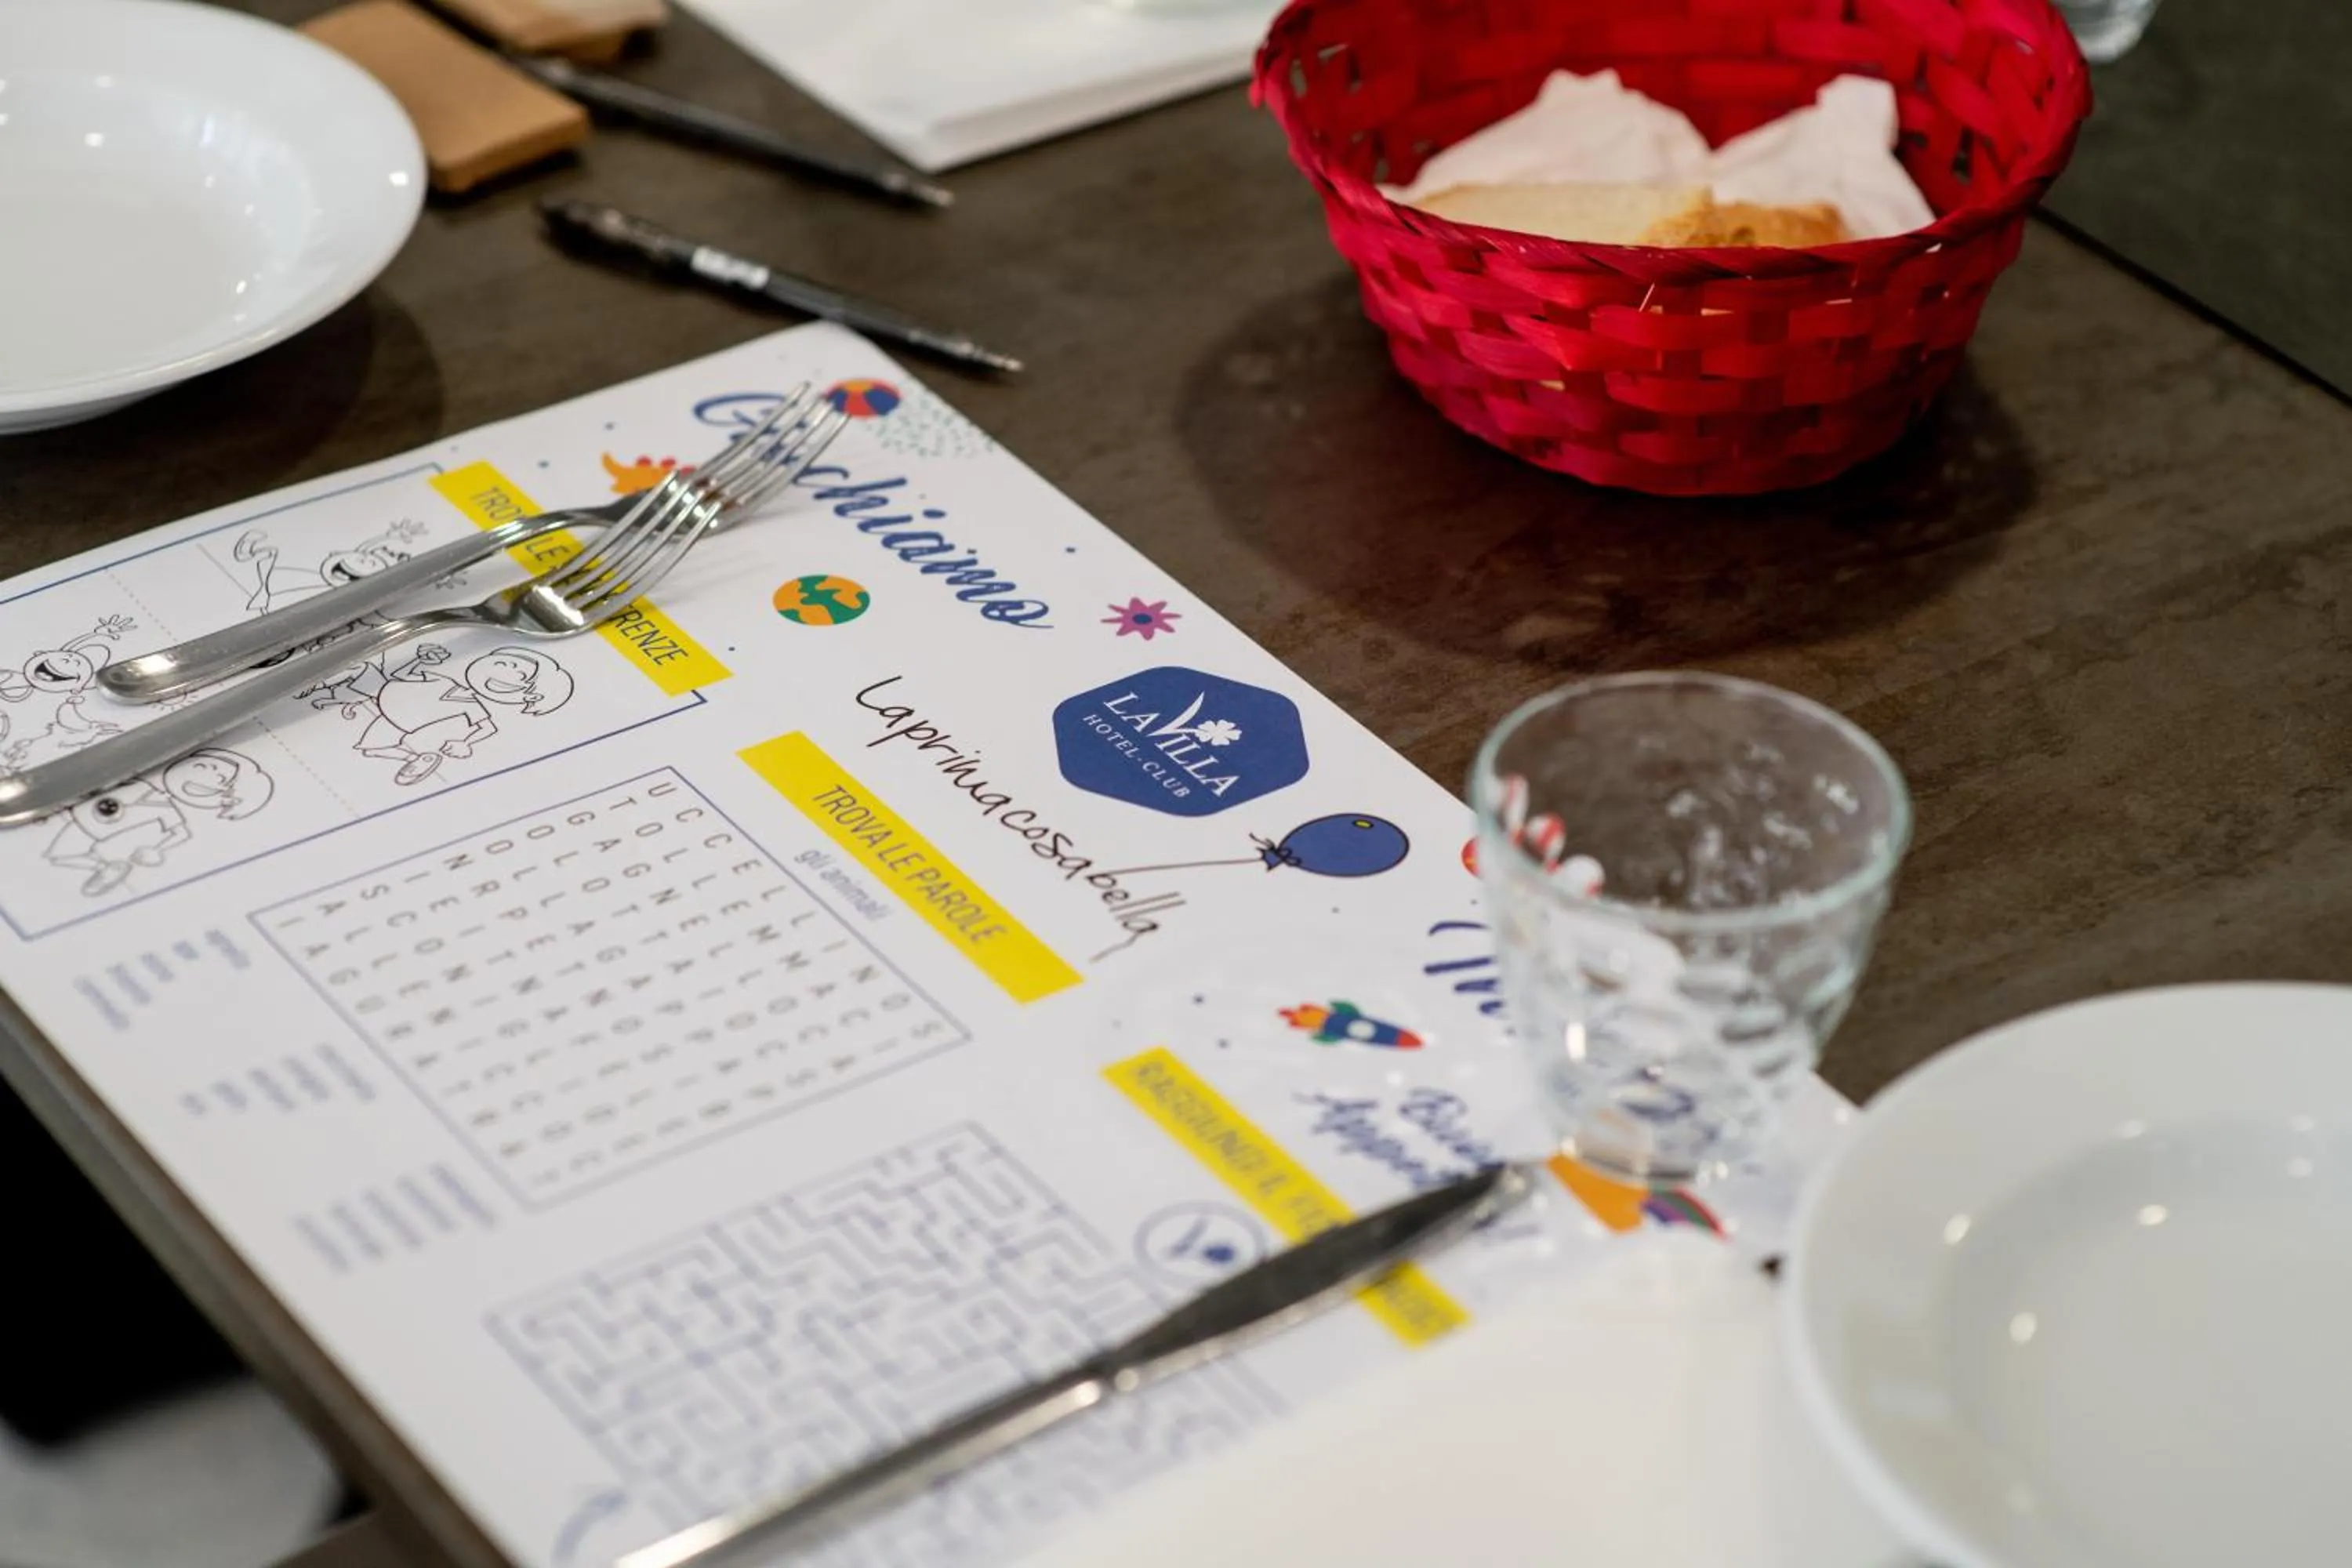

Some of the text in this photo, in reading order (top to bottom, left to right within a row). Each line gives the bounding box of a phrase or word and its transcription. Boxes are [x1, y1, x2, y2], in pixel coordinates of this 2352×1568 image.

[525, 535, 571, 563] LE
[444, 854, 473, 870] N
[472, 880, 500, 897] R
[485, 840, 514, 855] O
[512, 866, 538, 881] L
[539, 891, 565, 909] L
[527, 825, 555, 840] O
[553, 851, 579, 867] L
[582, 877, 611, 892] O
[567, 811, 596, 826] G
[593, 839, 622, 852] A
[622, 863, 652, 878] G
[651, 888, 679, 905] N
[678, 915, 710, 931] E
[609, 797, 637, 811] T
[635, 822, 664, 837] O
[662, 848, 688, 863] L
[691, 873, 717, 890] L
[720, 900, 751, 916] E
[648, 782, 677, 797] U
[675, 808, 704, 822] C
[703, 833, 732, 848] C
[731, 859, 762, 874] E
[760, 885, 786, 902] L
[790, 911, 815, 927] L
[793, 849, 896, 921] gli animali
[812, 784, 1009, 944] TROVA LE PAROLE
[360, 884, 390, 901] S
[387, 911, 418, 927] C
[429, 896, 459, 912] E
